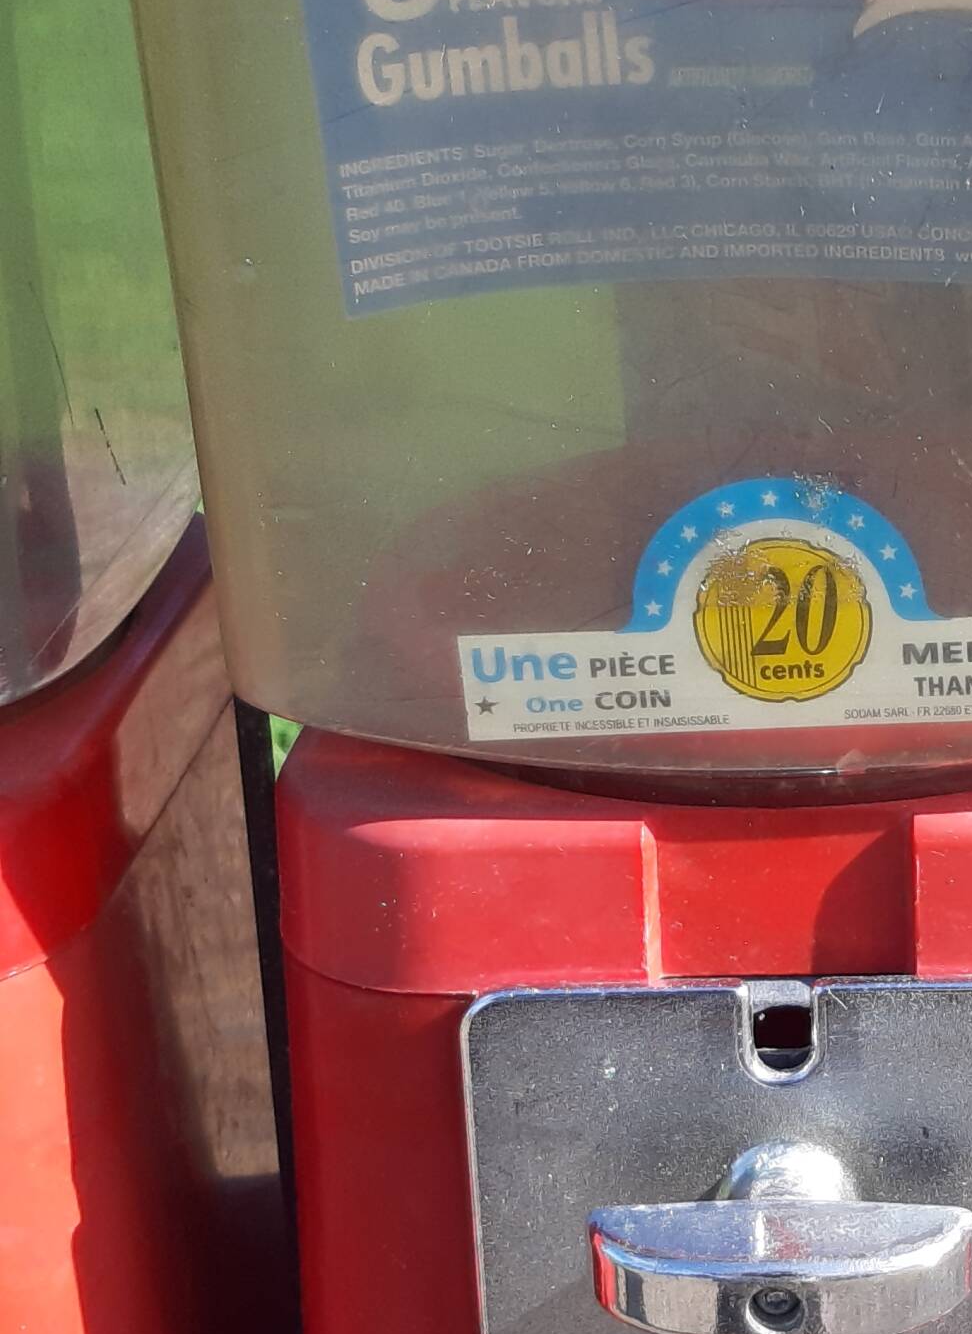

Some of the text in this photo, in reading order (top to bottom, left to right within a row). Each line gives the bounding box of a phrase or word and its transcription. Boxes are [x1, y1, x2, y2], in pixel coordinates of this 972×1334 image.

[356, 10, 657, 107] Gumballs
[622, 133, 667, 150] Corn
[671, 131, 722, 149] Syrup
[915, 131, 957, 148] Gum
[344, 202, 380, 222] Red
[705, 173, 748, 189] Corn
[347, 228, 381, 245] Soy
[424, 215, 449, 231] be
[350, 247, 430, 276] DIVISION
[433, 241, 458, 259] OF
[463, 232, 543, 254] TOOTSIE
[547, 229, 596, 246] ROLL
[650, 224, 686, 241] LLC
[690, 222, 781, 240] CHICAGO,
[785, 222, 801, 237] IL
[805, 222, 857, 239] 60629
[861, 223, 897, 239] USA
[353, 272, 406, 297] MADE
[407, 268, 430, 284] IN
[433, 257, 512, 281] CANADA
[516, 252, 572, 272] FROM
[576, 245, 674, 266] DOMESTIC
[679, 243, 719, 260] AND
[723, 243, 819, 259] IMPORTED
[823, 243, 946, 263] INGREDIENTS
[751, 564, 839, 657] 20
[471, 646, 676, 684] Une PIÈCE
[759, 659, 826, 681] cents
[526, 689, 672, 714] One COIN
[884, 707, 910, 719] SARL
[917, 705, 931, 718] FR
[574, 718, 635, 732] INCESSIBLE
[637, 717, 650, 729] ET
[653, 714, 730, 728] INSAISISSABLE
